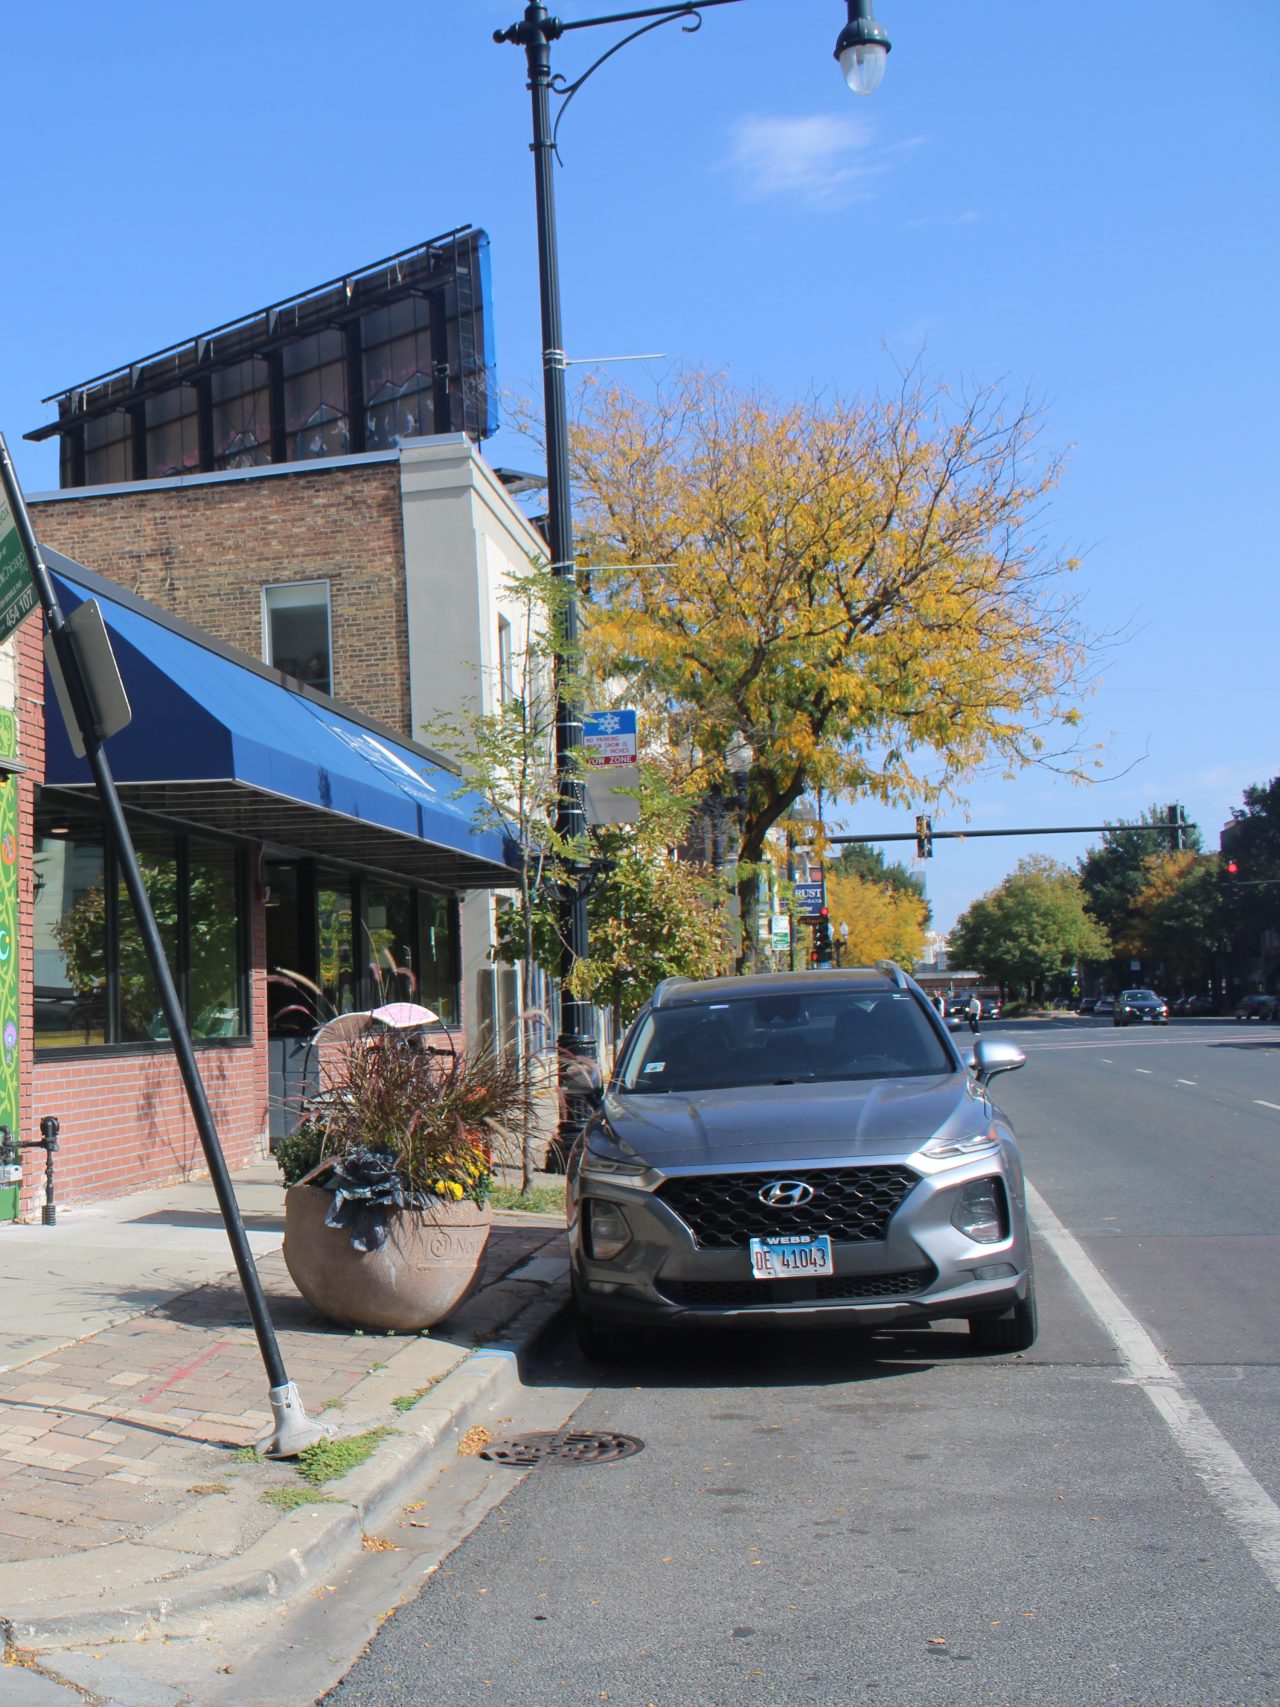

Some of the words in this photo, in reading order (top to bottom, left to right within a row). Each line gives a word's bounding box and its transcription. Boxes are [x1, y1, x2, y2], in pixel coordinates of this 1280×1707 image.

[5, 608, 21, 630] 454
[19, 593, 34, 614] 107
[610, 756, 632, 764] ZONE
[766, 1236, 810, 1244] WEBB
[755, 1251, 773, 1270] DE
[782, 1248, 827, 1269] 41043
